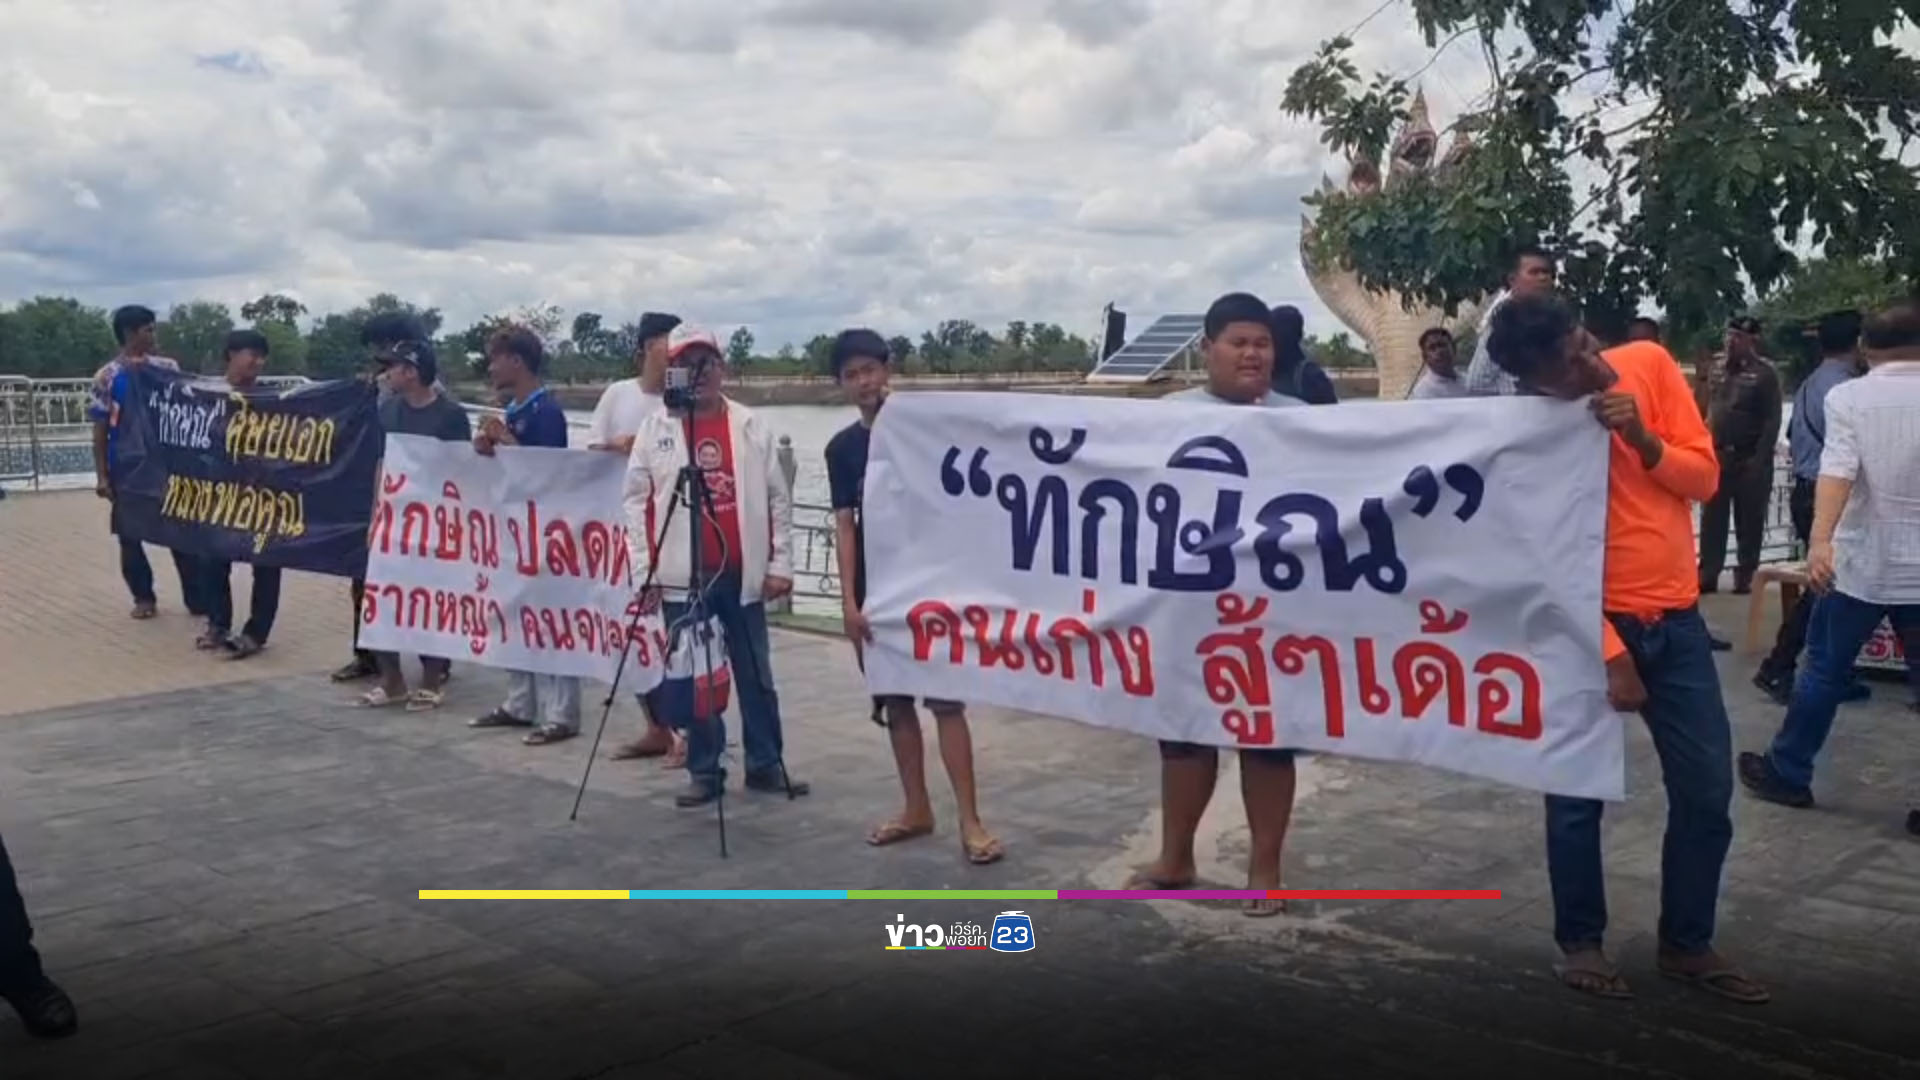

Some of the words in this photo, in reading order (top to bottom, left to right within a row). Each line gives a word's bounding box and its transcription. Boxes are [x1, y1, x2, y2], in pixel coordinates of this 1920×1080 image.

[941, 426, 1485, 594] “ทักษิณ”
[364, 572, 507, 655] รากหญ้า
[907, 590, 1154, 697] คนเก่ง
